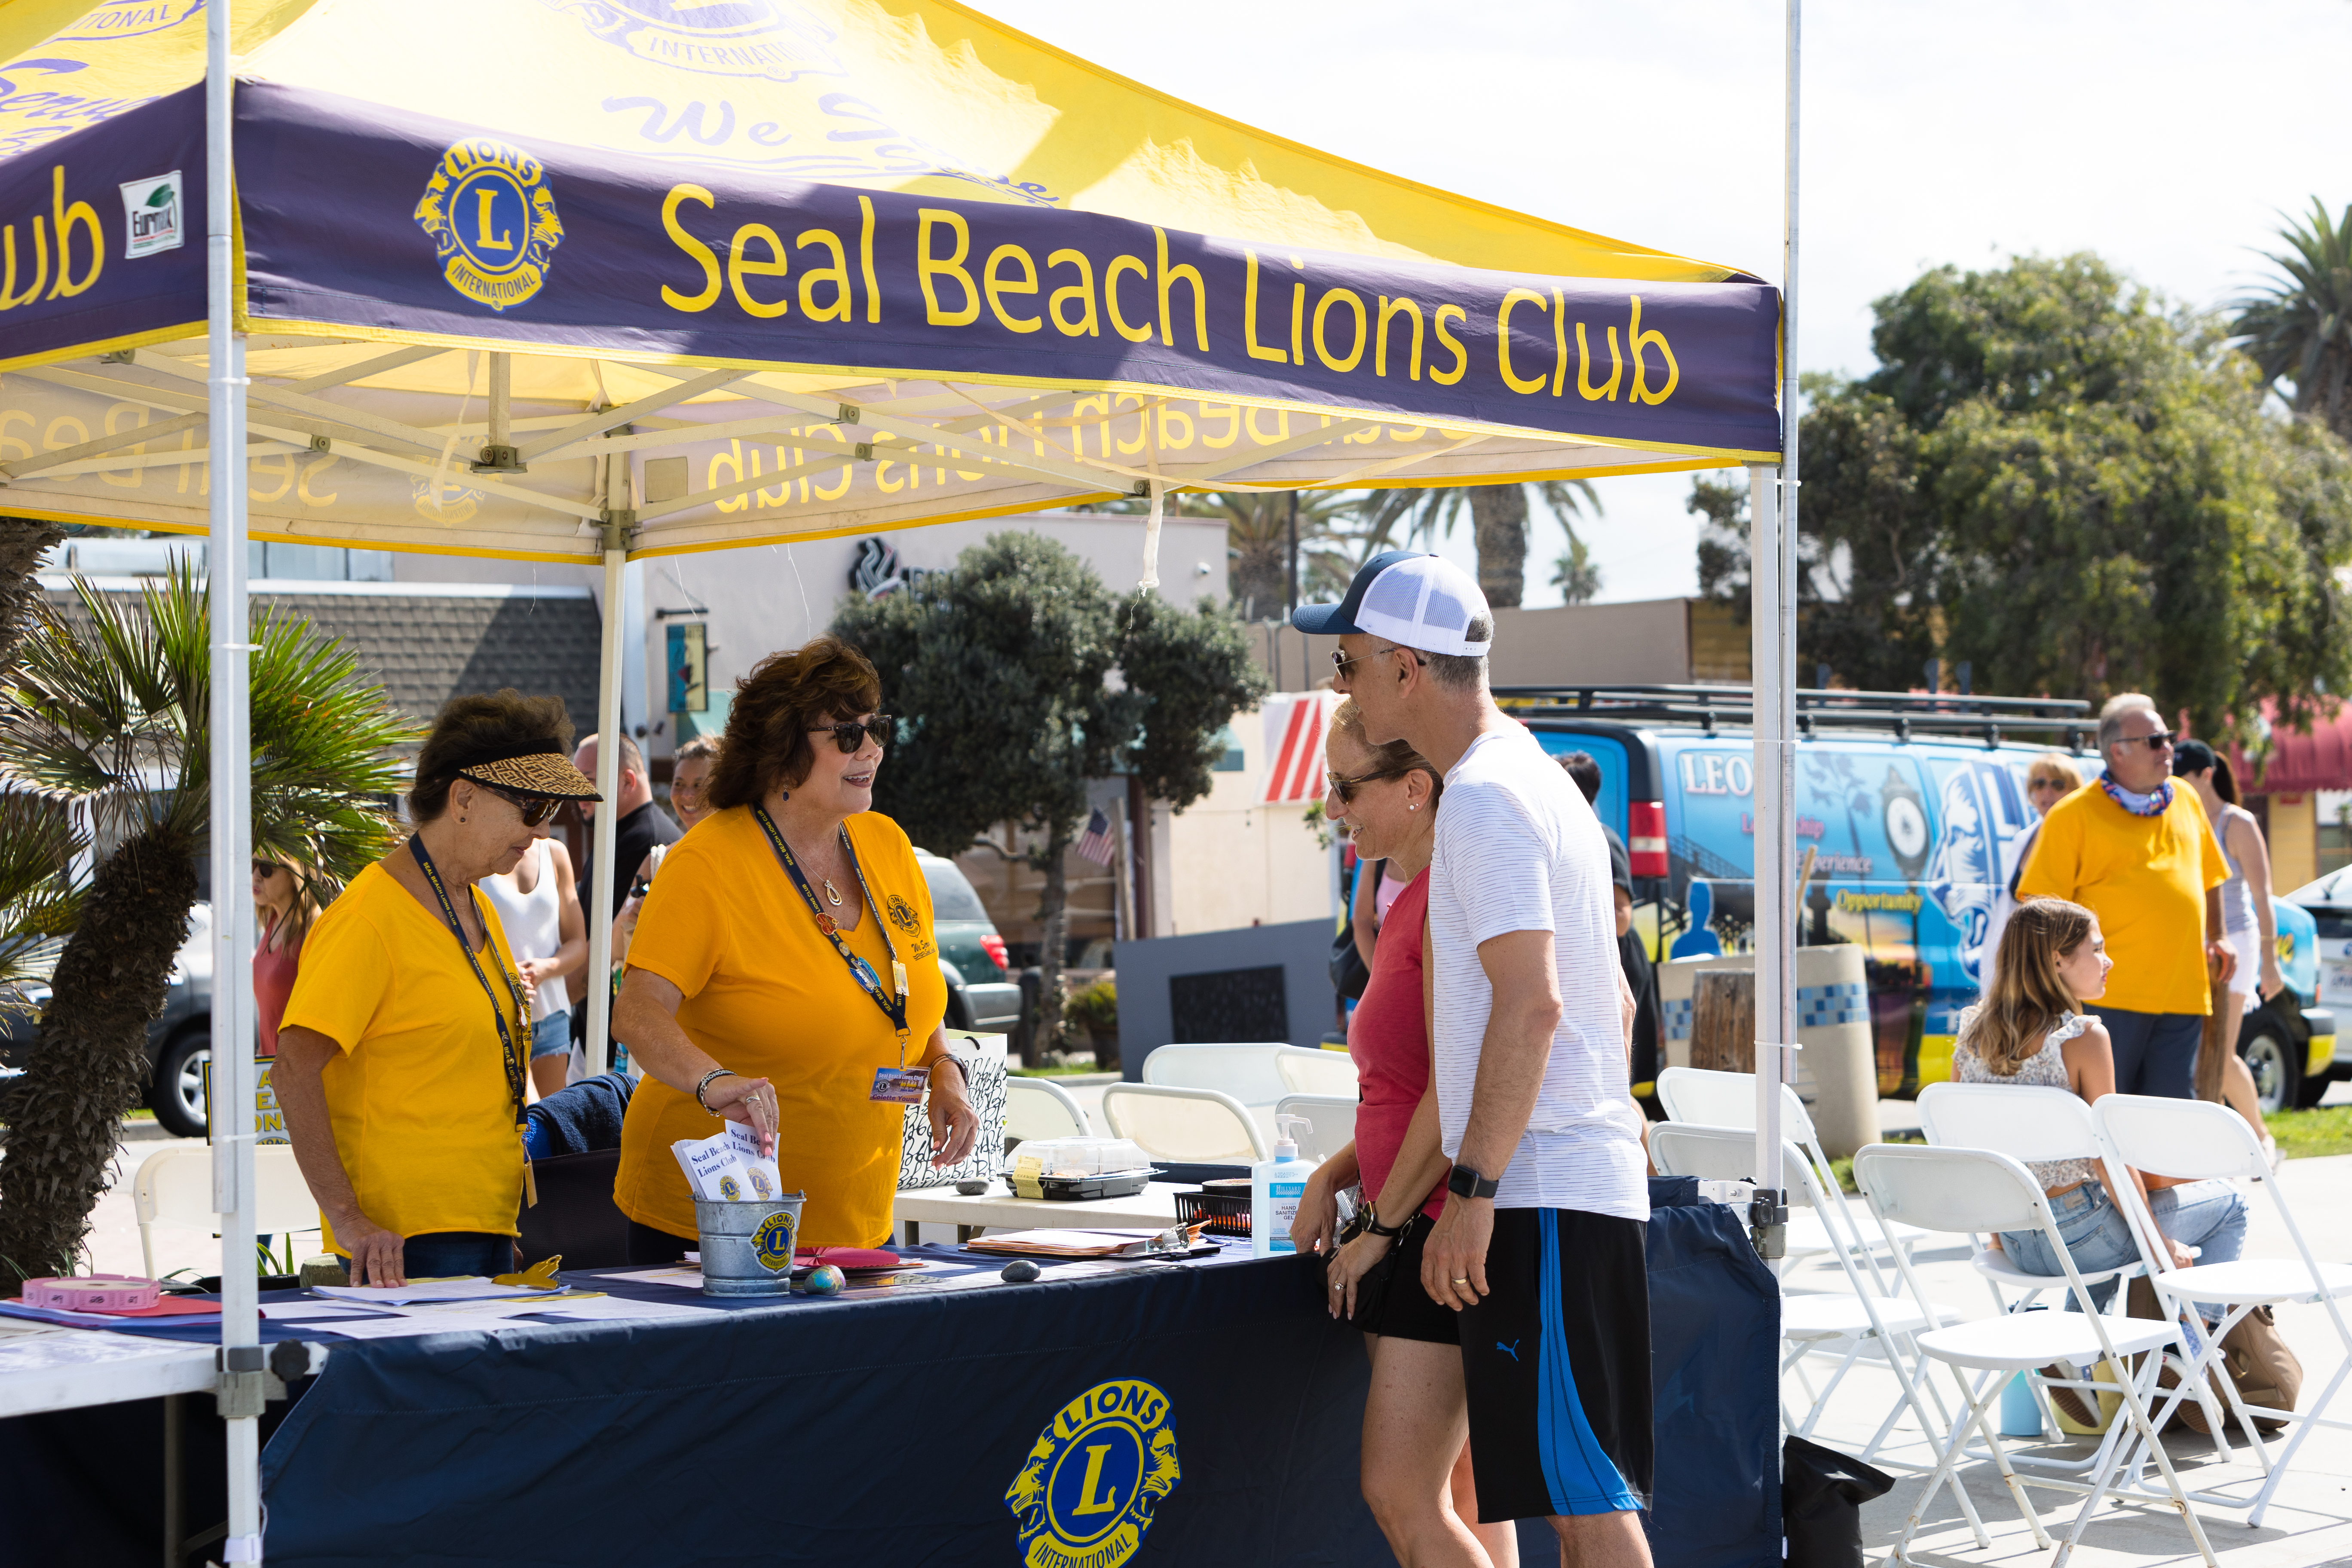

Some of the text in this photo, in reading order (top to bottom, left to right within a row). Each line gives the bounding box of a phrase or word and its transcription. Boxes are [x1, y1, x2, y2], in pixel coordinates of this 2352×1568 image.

[602, 95, 792, 146] We
[449, 141, 537, 181] LIONS
[475, 188, 513, 251] L
[451, 263, 536, 299] INTERNATIONAL
[661, 182, 1679, 405] Seal Beach Lions Club
[1680, 753, 1754, 797] LEO
[757, 810, 793, 866] SEAL BEACH LIONS CLUB
[423, 862, 456, 926] SEAL BEACH LIONS CLUB
[802, 884, 812, 897] CLUB
[810, 897, 821, 912] LIONS
[1836, 888, 1923, 915] Opportunity
[465, 946, 498, 1009] SEAL BEACH LIONS CLUB
[873, 986, 892, 1011] SEAL BEAC
[731, 1129, 747, 1142] Seal
[732, 1142, 754, 1156] Lions
[691, 1142, 730, 1165] Seal Beach
[697, 1155, 737, 1178] Lions Club
[767, 1215, 793, 1227] LIONS
[773, 1231, 785, 1250] L
[1062, 1384, 1162, 1433] LIONS
[1072, 1444, 1117, 1516] L
[1033, 1533, 1132, 1568] INTERNATIONAL
